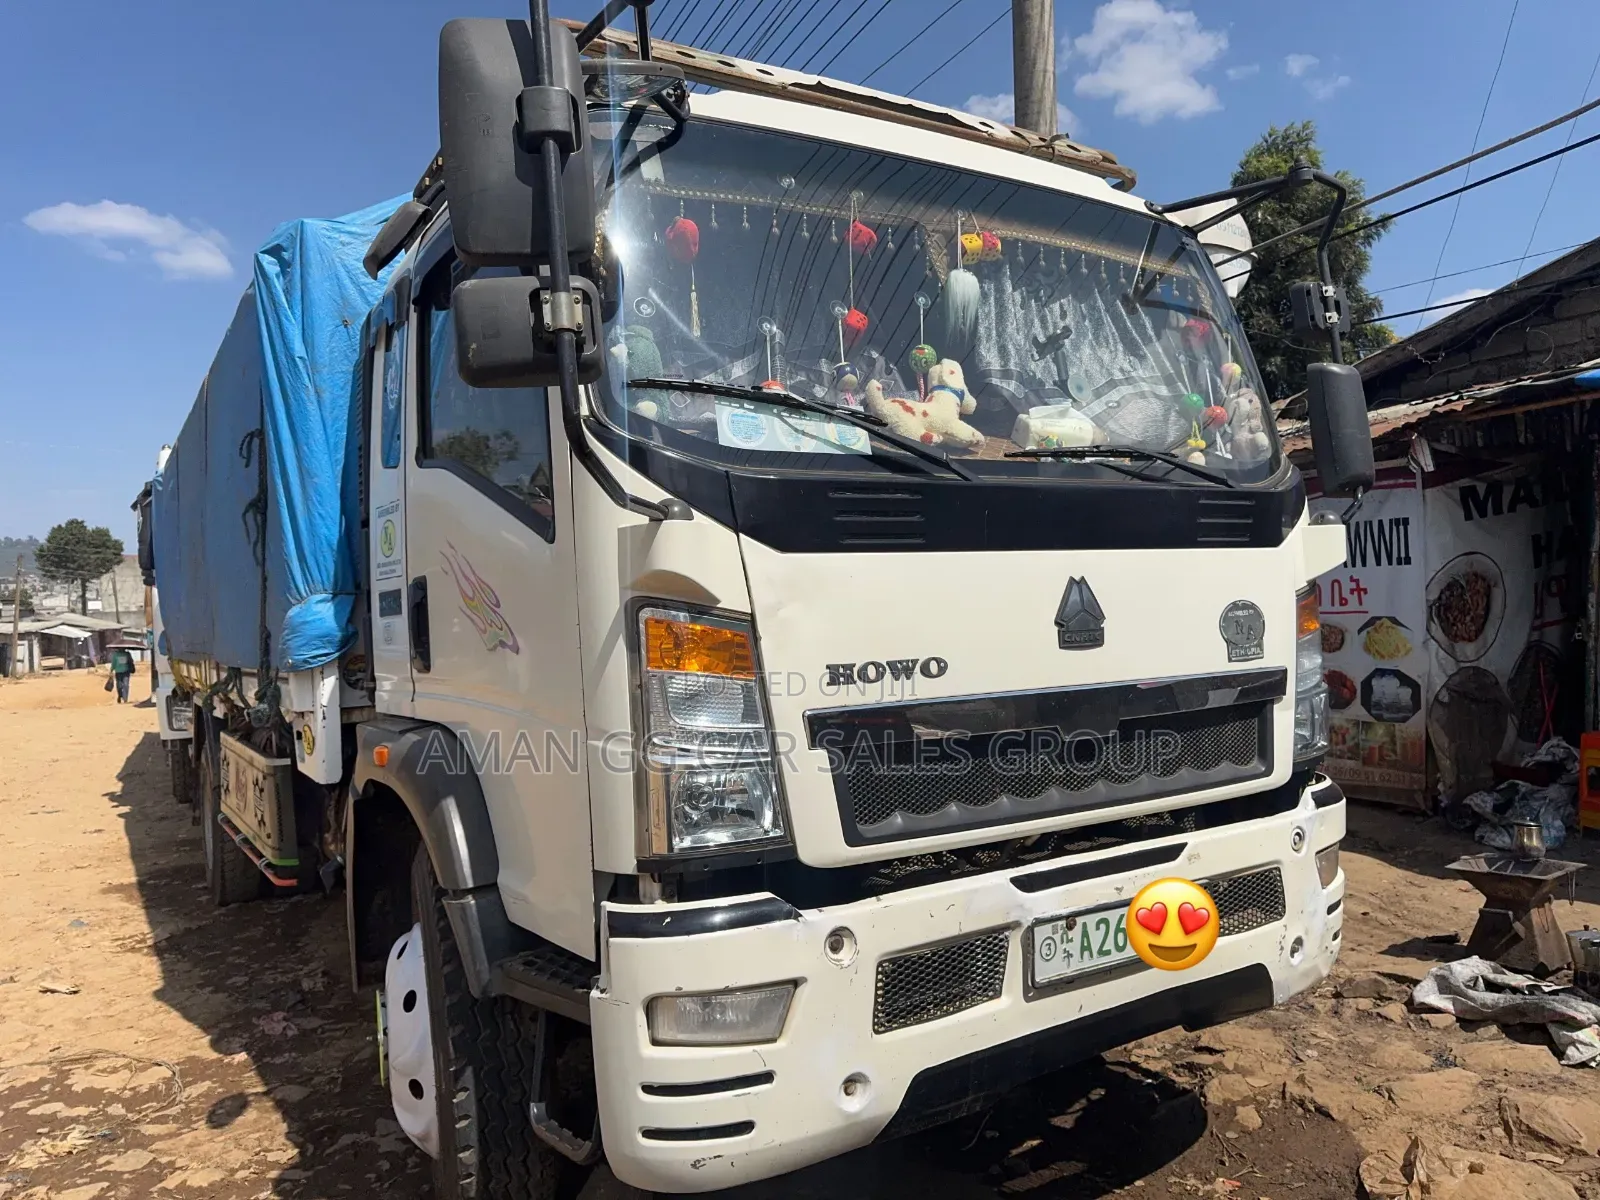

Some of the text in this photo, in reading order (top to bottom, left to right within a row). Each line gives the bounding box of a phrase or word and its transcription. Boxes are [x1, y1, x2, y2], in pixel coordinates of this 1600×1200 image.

[1342, 517, 1412, 568] WWII
[826, 656, 949, 686] HOWO
[1079, 913, 1127, 961] A26
